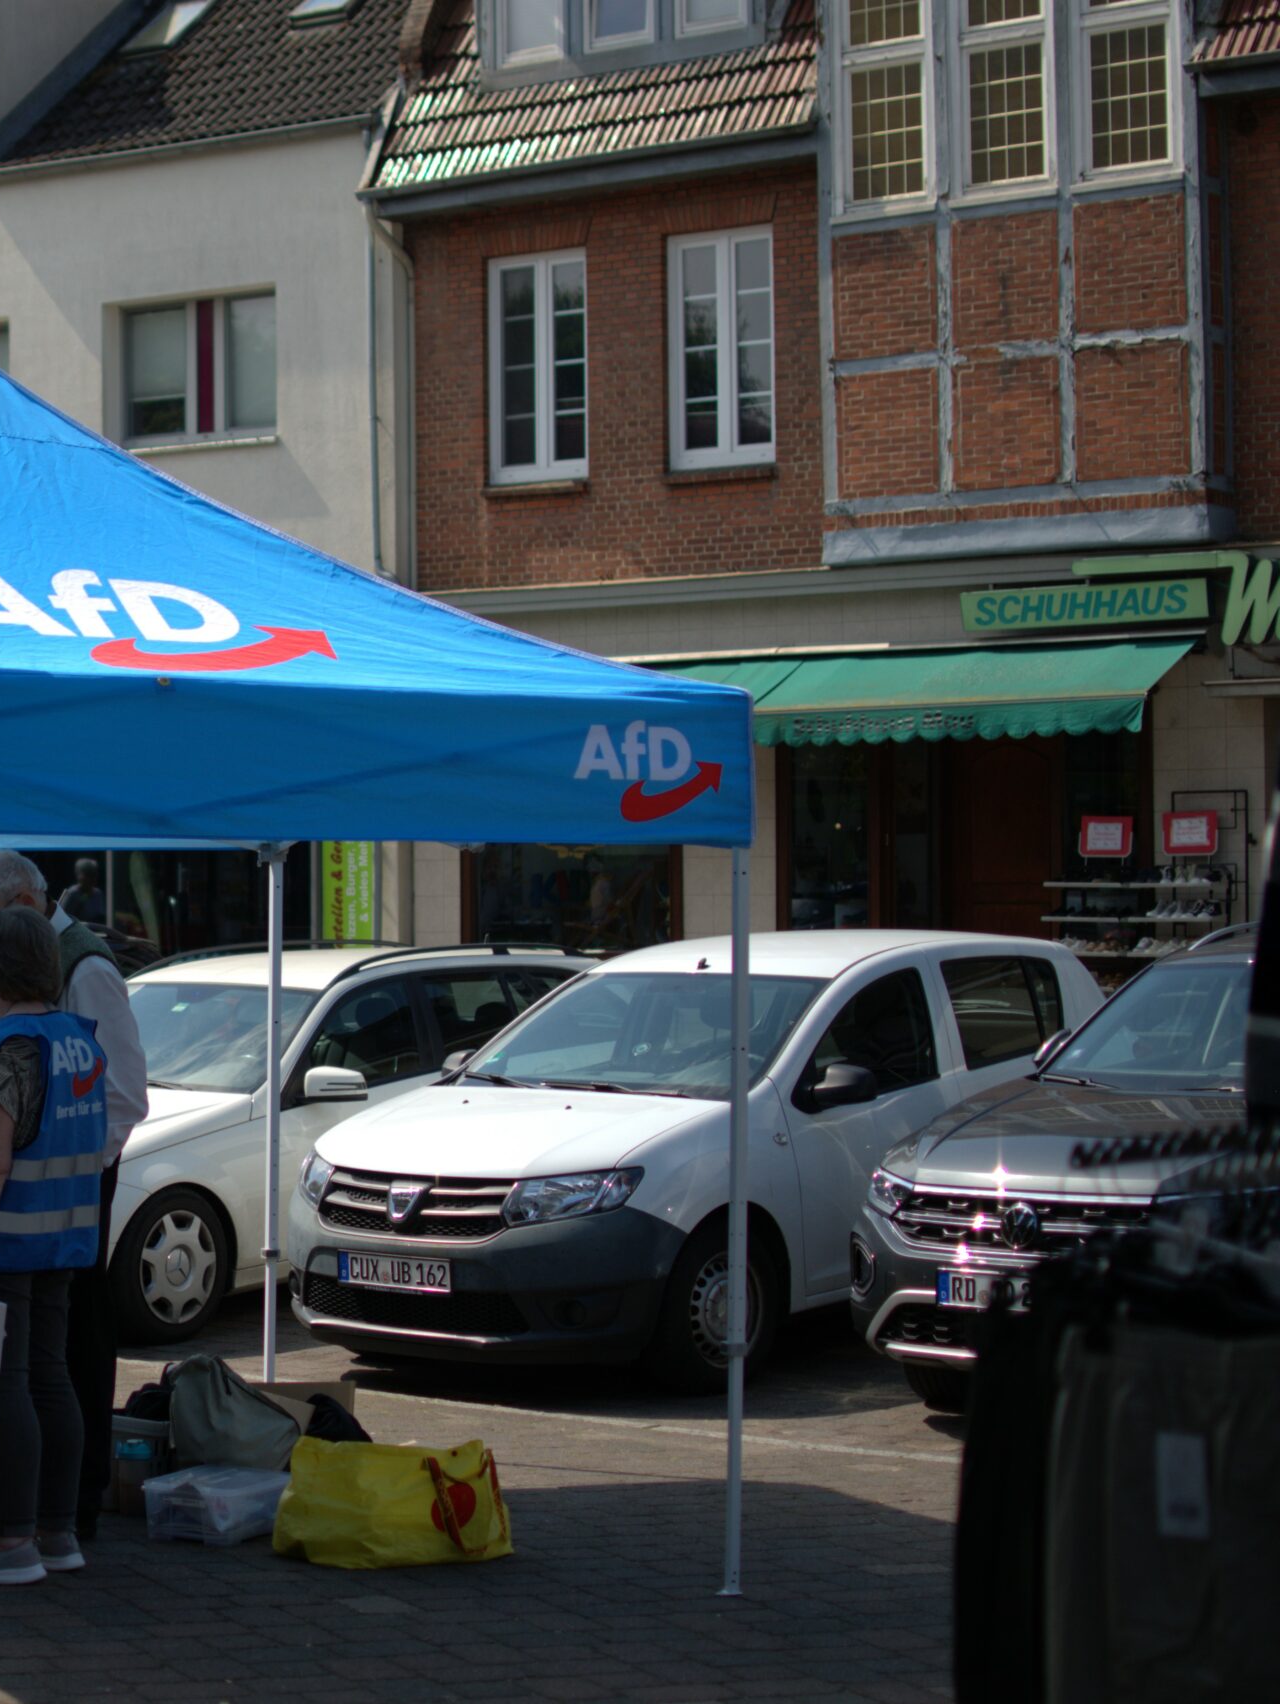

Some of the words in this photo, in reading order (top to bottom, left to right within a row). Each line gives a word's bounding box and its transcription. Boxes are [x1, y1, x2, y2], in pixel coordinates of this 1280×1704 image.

[974, 583, 1189, 627] SCHUHHAUS
[573, 720, 692, 781] AfD
[52, 1035, 94, 1076] AfD
[350, 1256, 380, 1281] CUX
[390, 1260, 412, 1284] UB
[416, 1263, 448, 1288] 162
[951, 1275, 976, 1302] RD
